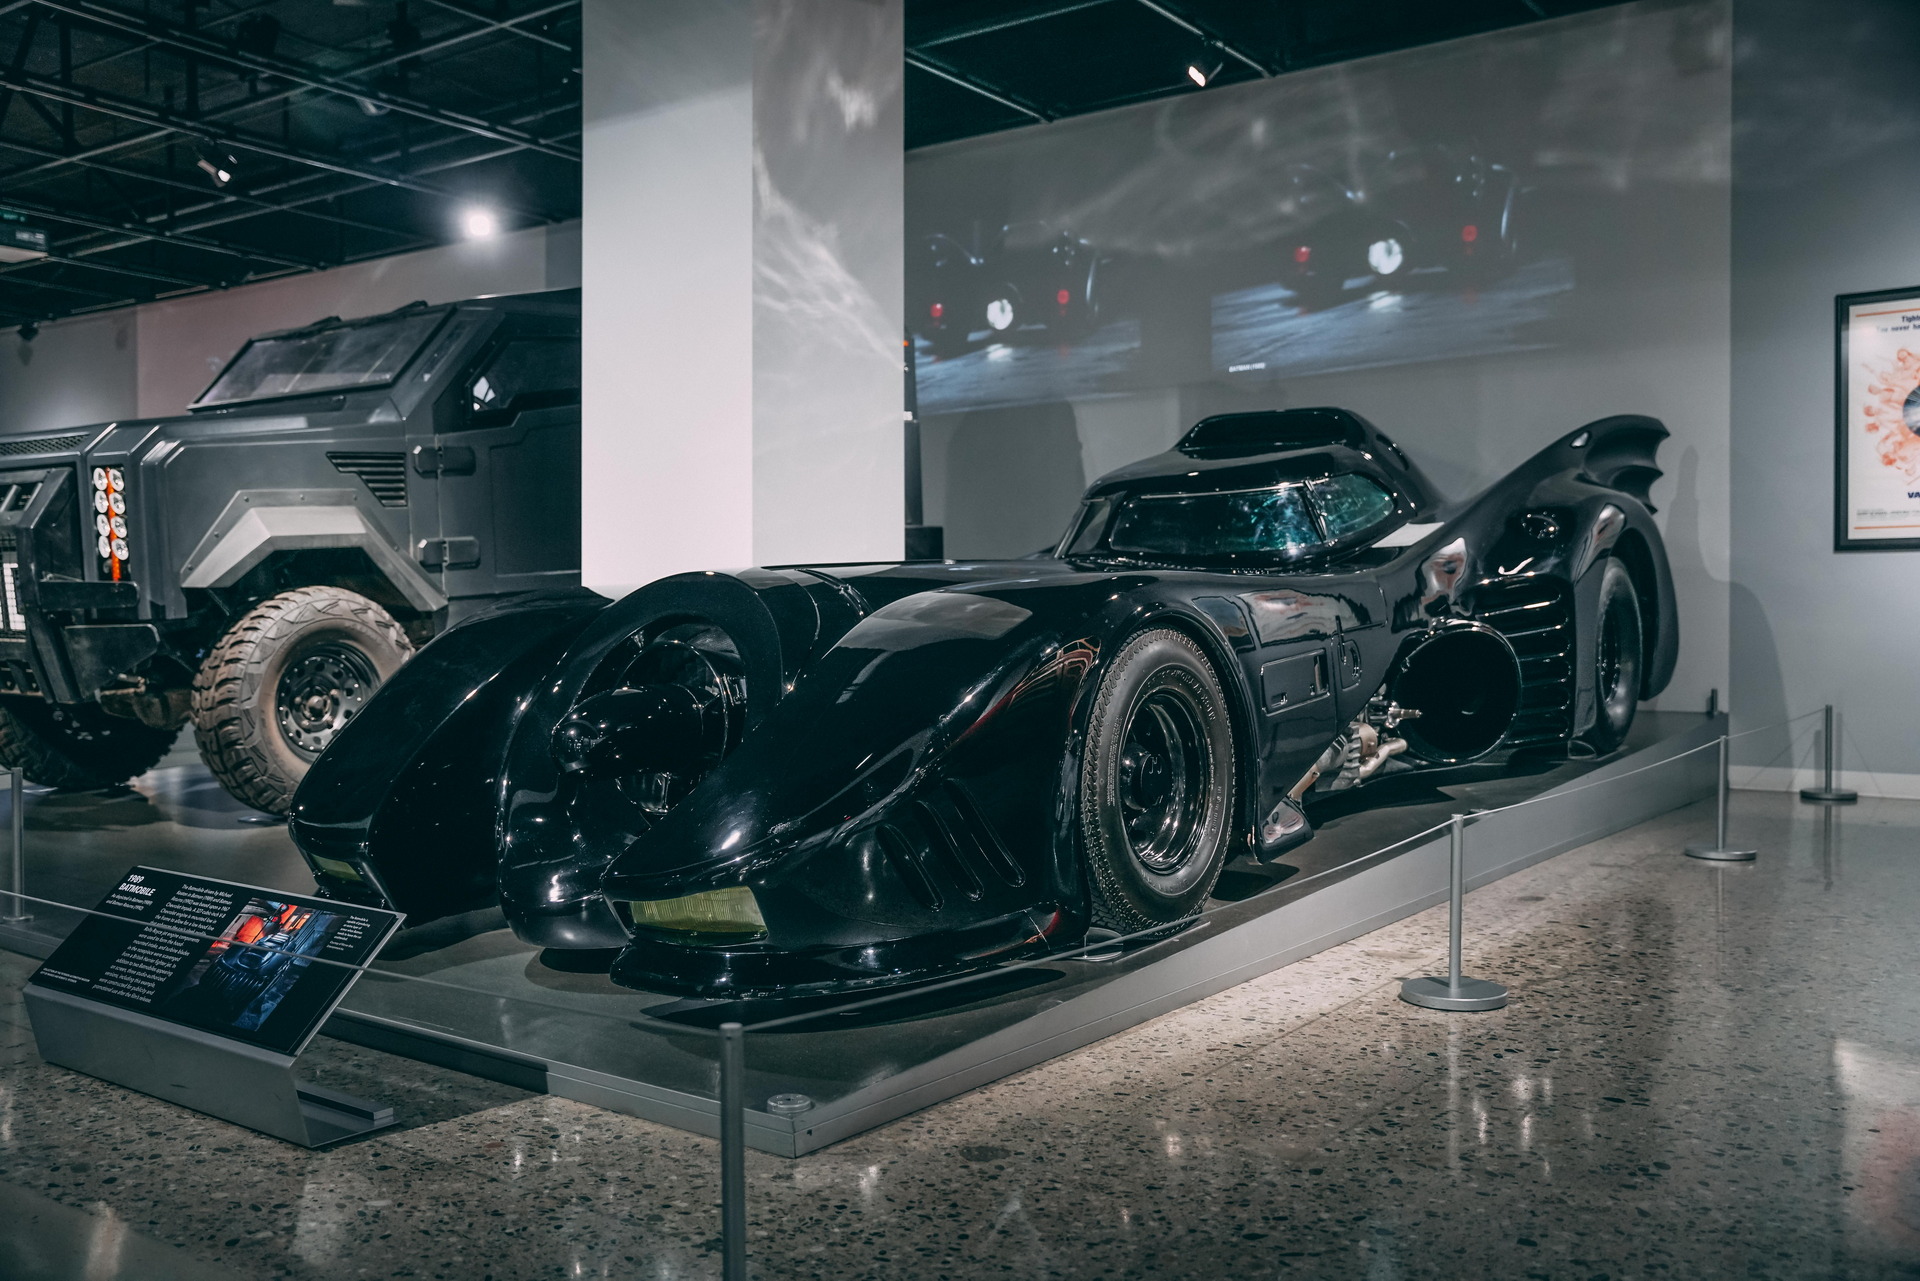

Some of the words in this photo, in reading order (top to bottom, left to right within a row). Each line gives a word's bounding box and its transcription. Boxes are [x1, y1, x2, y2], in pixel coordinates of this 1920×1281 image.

[1229, 364, 1250, 372] BATMAN
[128, 874, 144, 883] 1989
[119, 883, 156, 896] BATMOBILE
